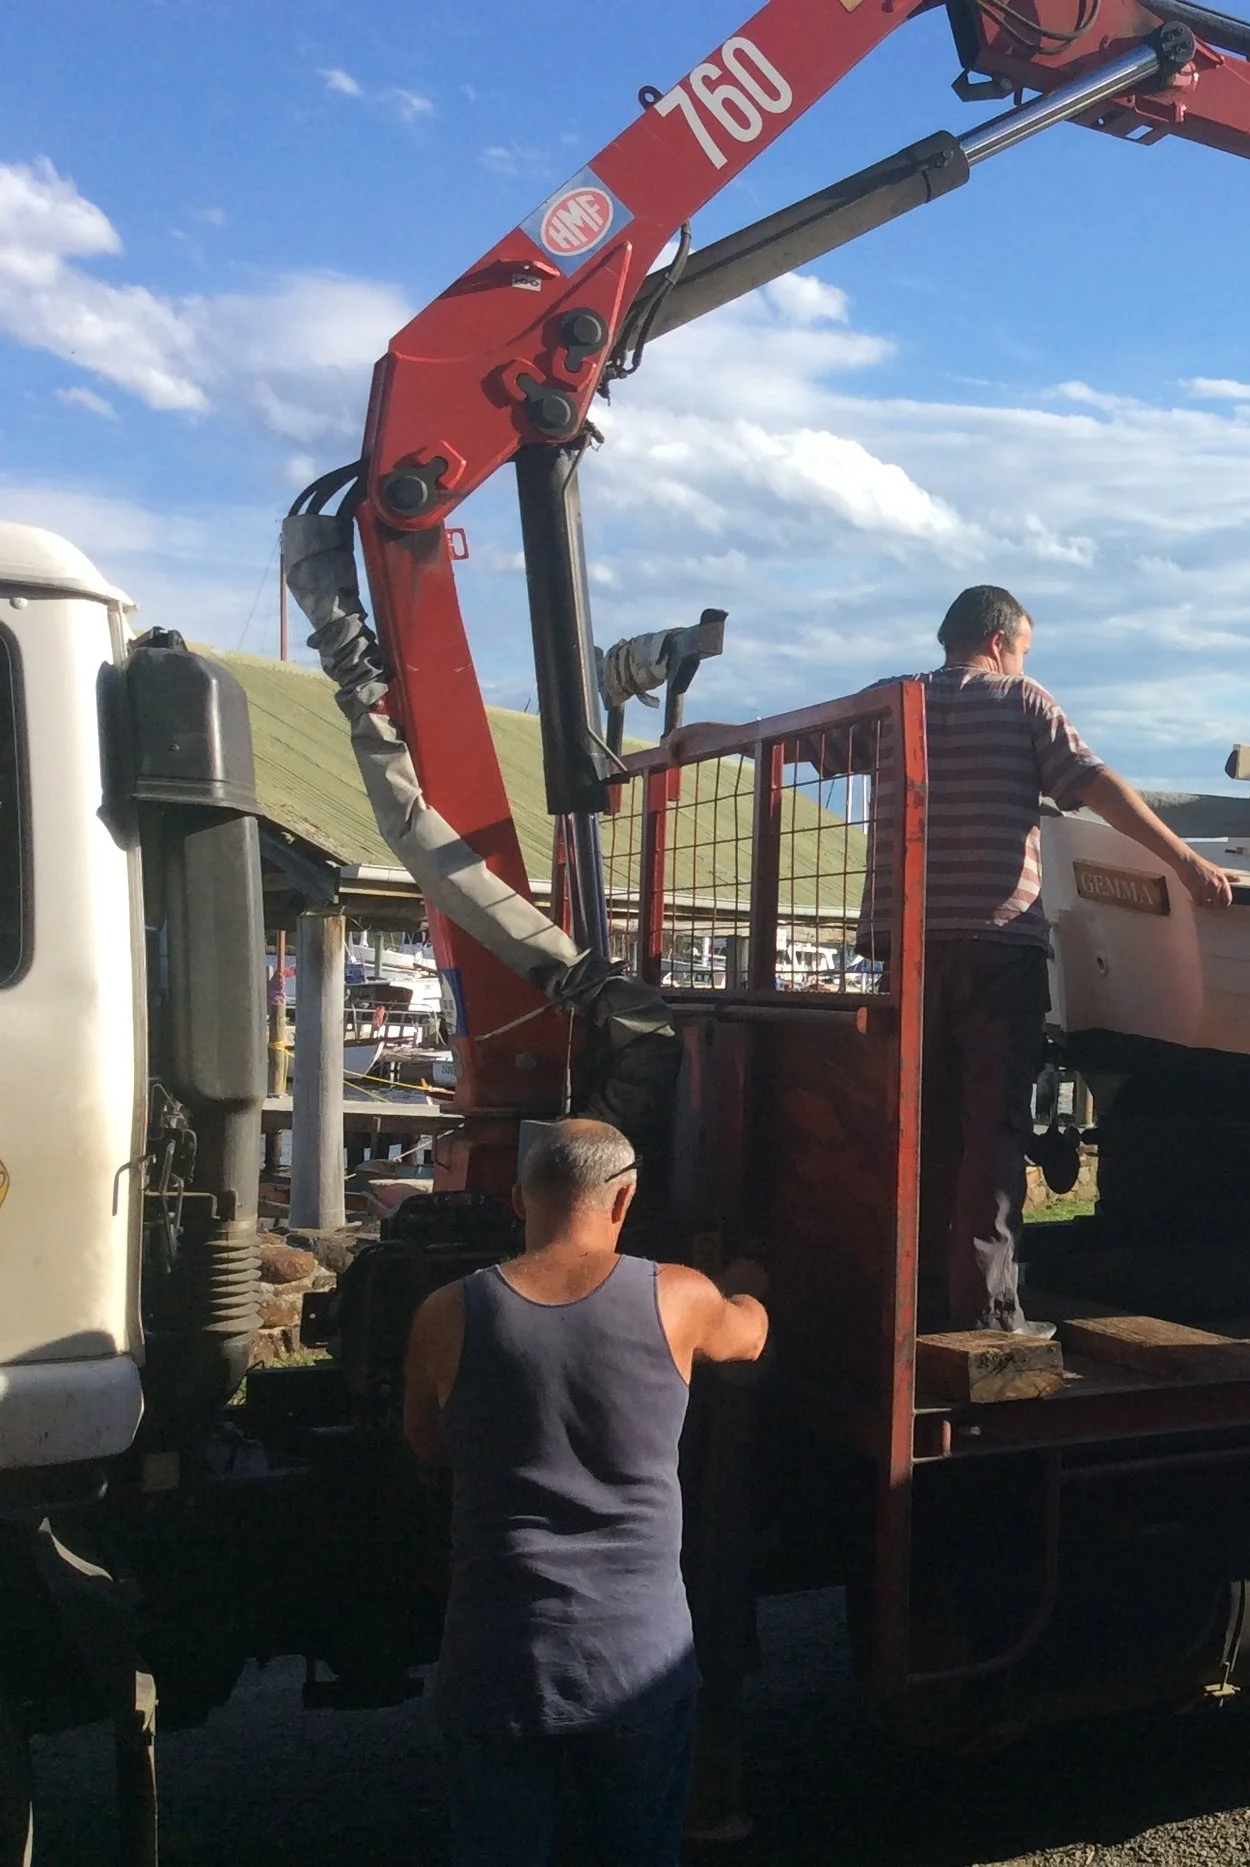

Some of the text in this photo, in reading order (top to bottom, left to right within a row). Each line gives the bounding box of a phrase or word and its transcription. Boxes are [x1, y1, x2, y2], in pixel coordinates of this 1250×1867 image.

[654, 36, 793, 170] 760
[549, 194, 603, 248] HMF
[1081, 872, 1154, 905] GEMMA
